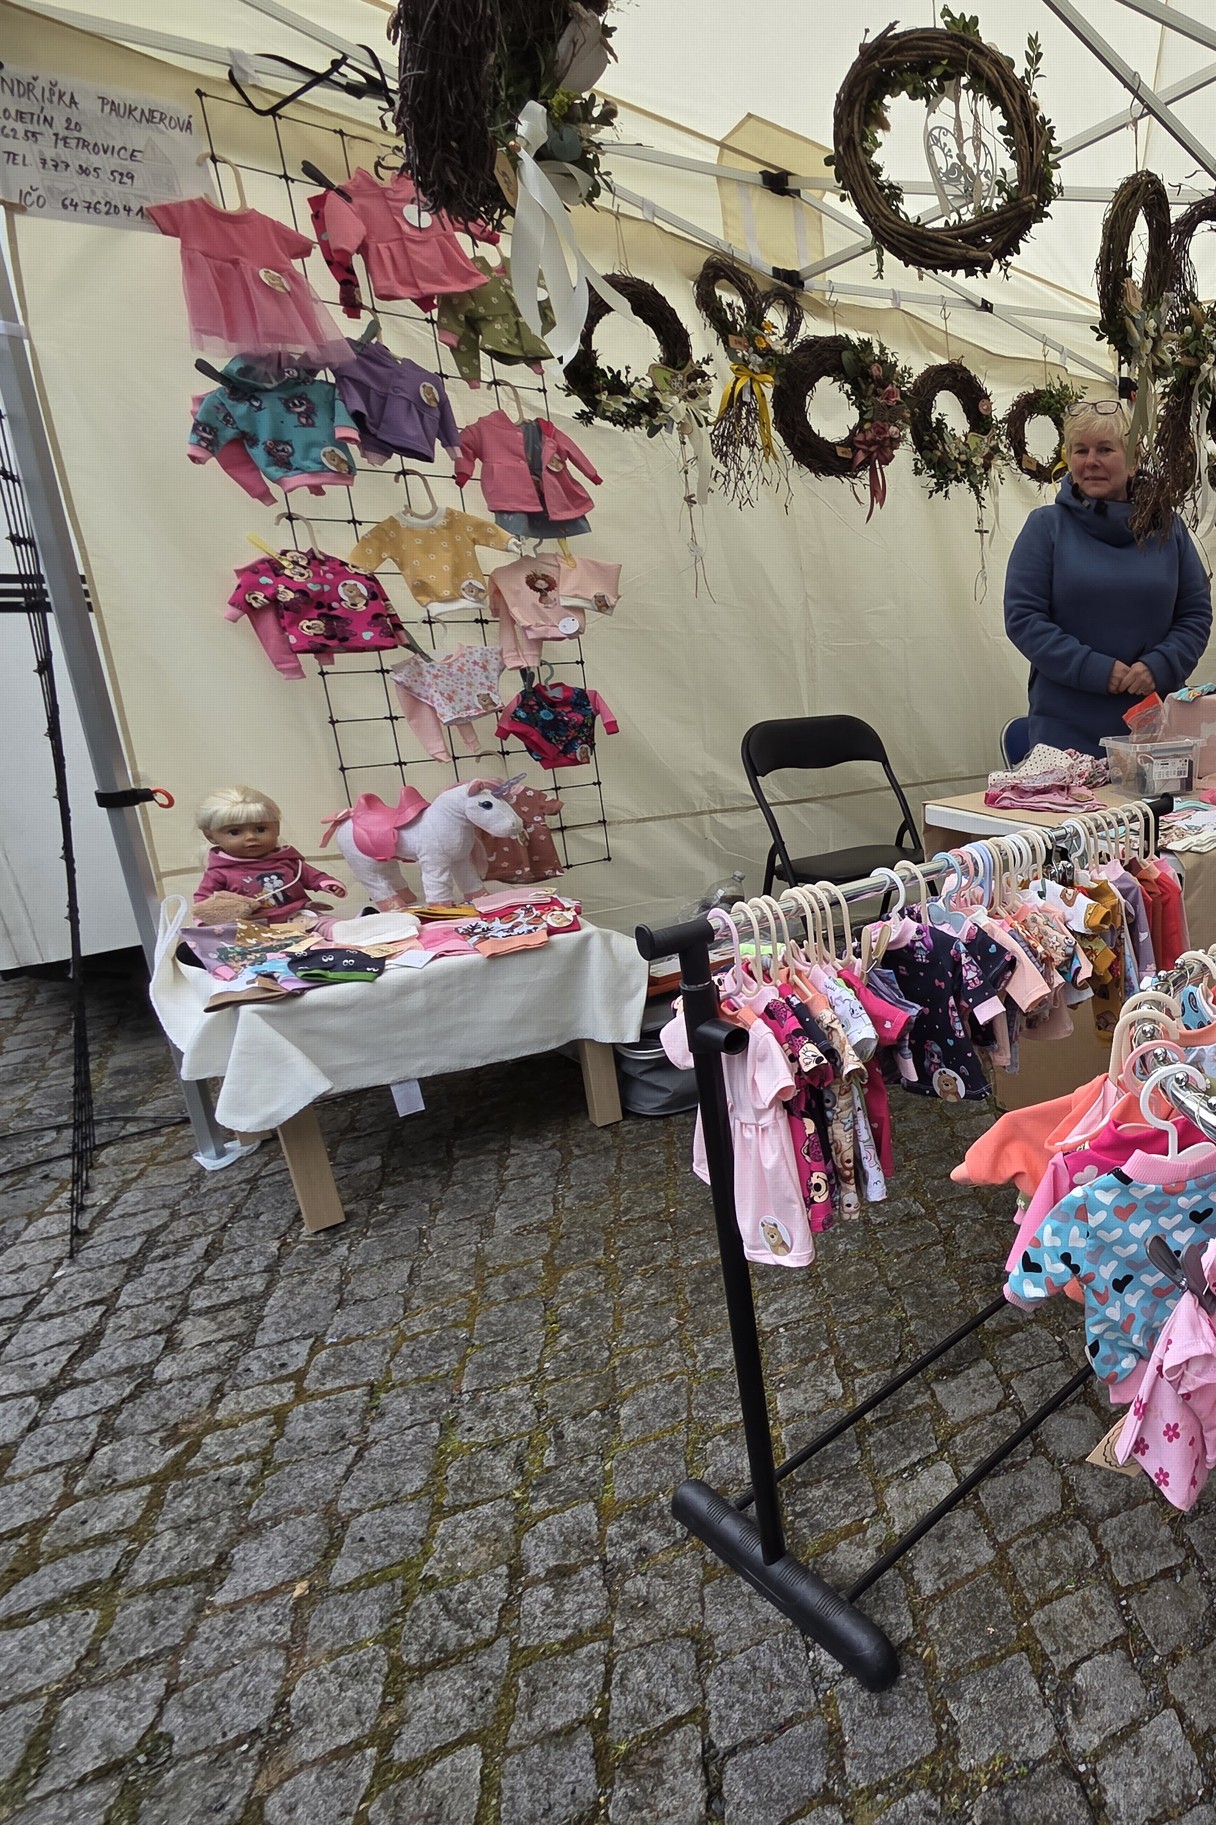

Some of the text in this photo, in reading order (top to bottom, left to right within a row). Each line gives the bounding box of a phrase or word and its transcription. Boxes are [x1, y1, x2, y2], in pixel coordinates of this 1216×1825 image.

[0, 105, 82, 132] OJETÍN 20
[97, 95, 193, 135] PAUKNEROVÁ
[39, 157, 70, 171] 777
[108, 169, 135, 187] 529
[19, 185, 47, 209] IČO
